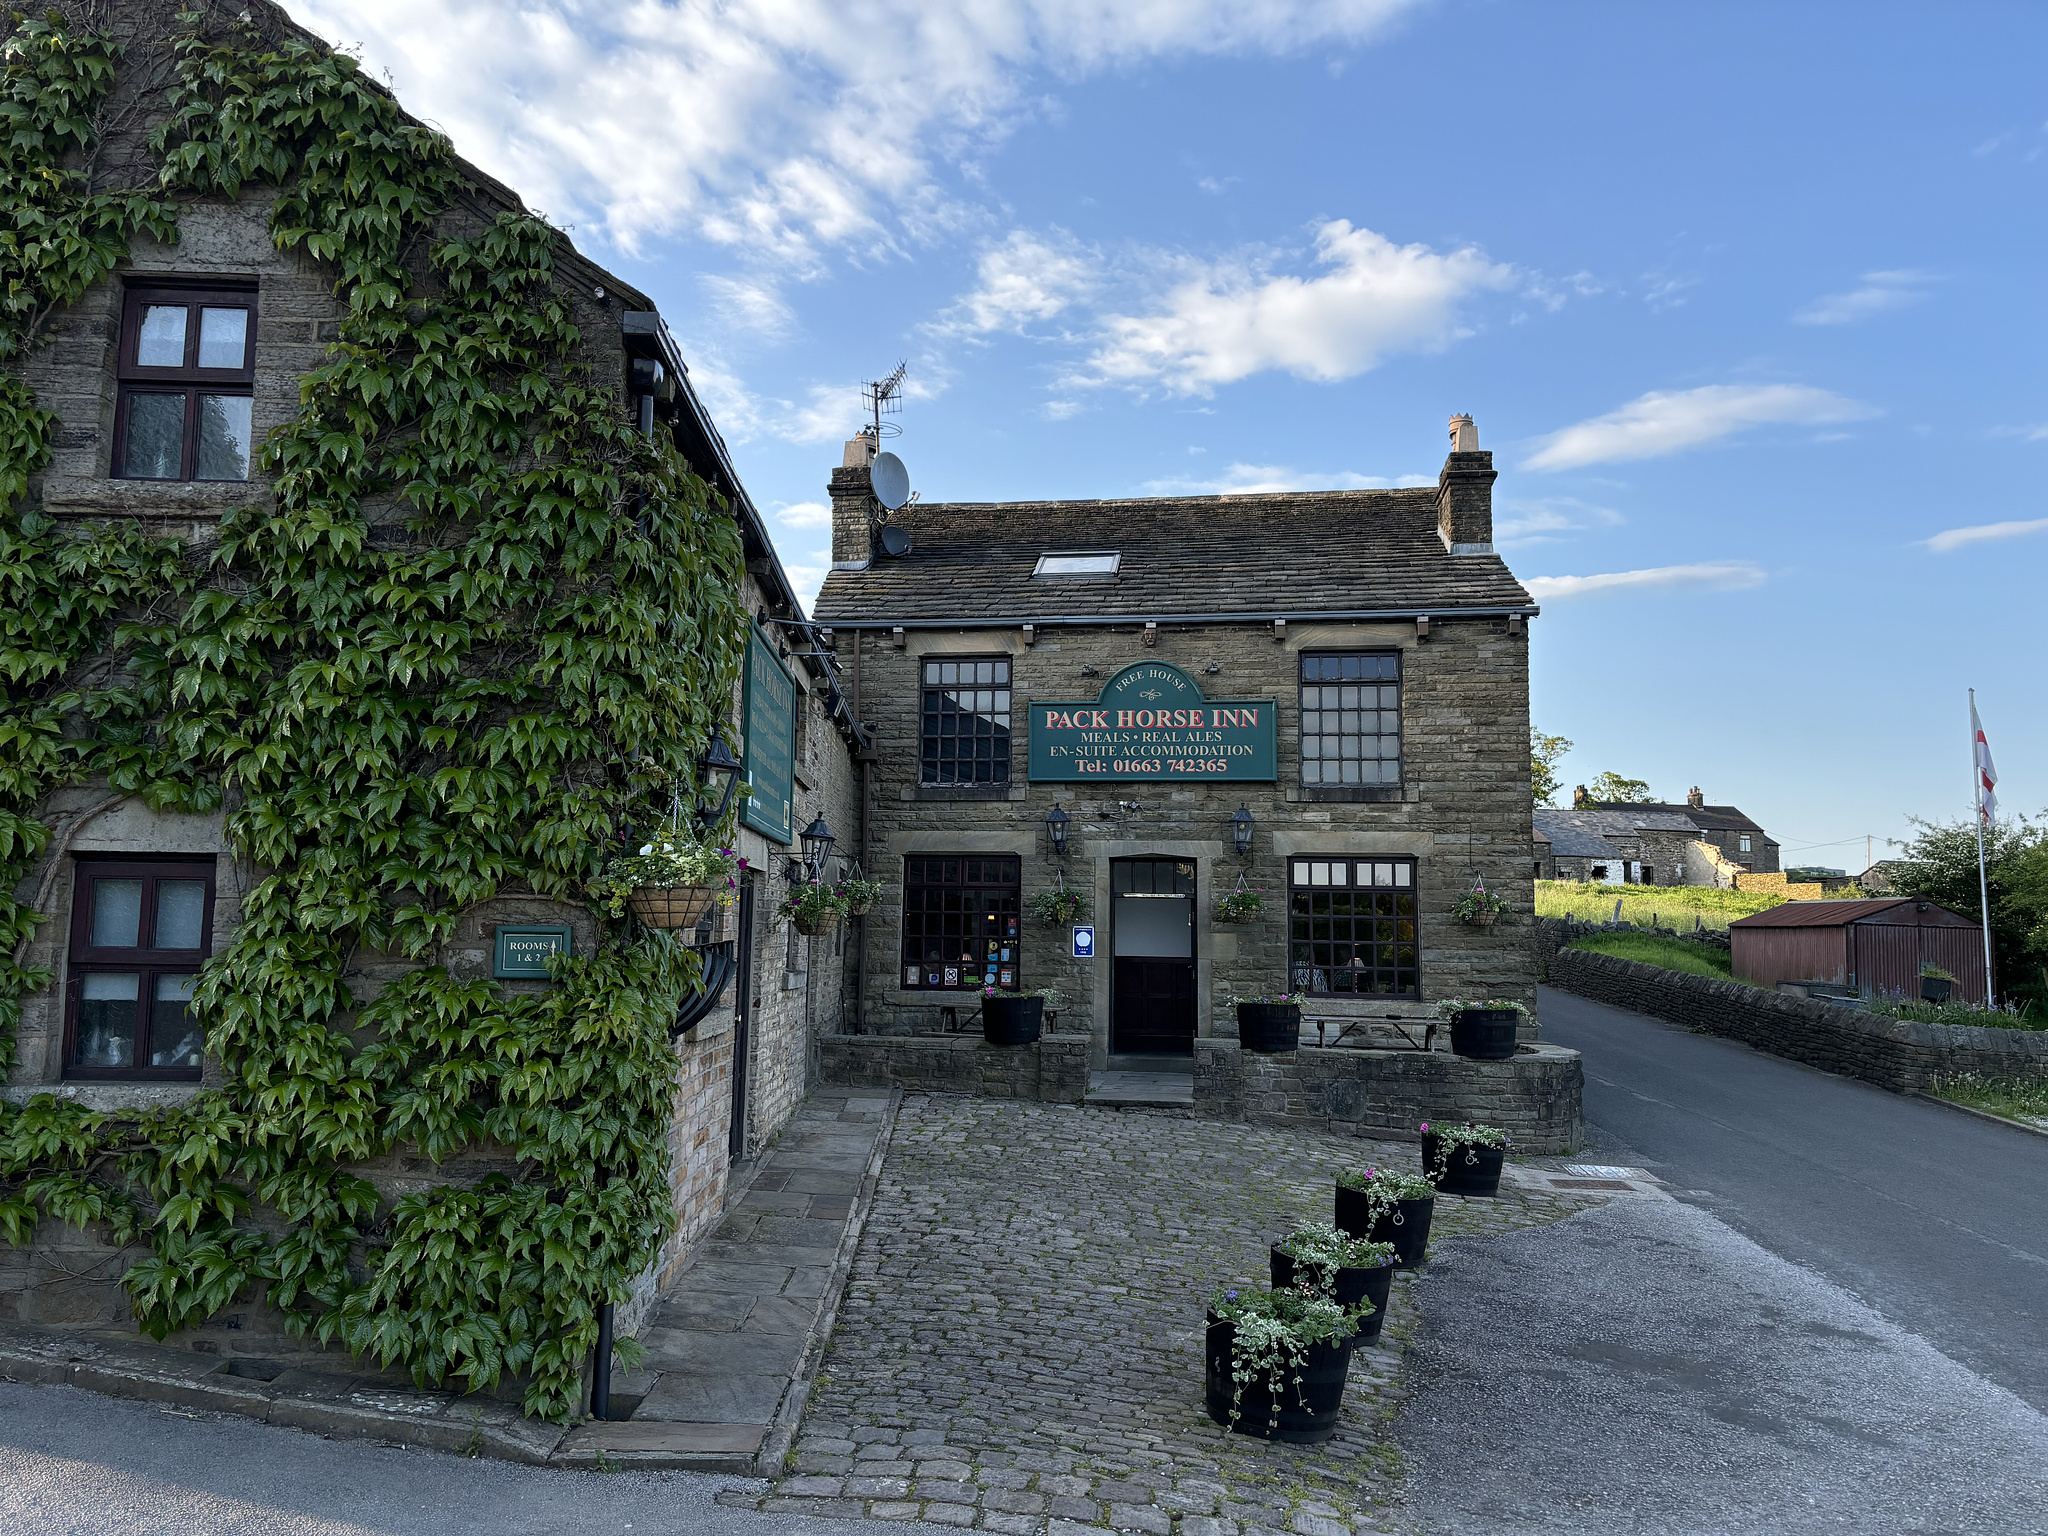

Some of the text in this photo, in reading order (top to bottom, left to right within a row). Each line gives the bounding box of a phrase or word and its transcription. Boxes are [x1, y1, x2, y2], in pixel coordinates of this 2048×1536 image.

[1115, 669, 1187, 692] FREE HOUSE
[1045, 709, 1259, 729] PACK HORSE INN
[1081, 731, 1222, 742] MEALS REAL ALES
[1050, 745, 1253, 756] EN-SUITE ACCOMMODATION
[1075, 759, 1227, 773] Tel: 01663 742365
[510, 942, 549, 950] ROOMS
[517, 953, 541, 962] 1 & 2
